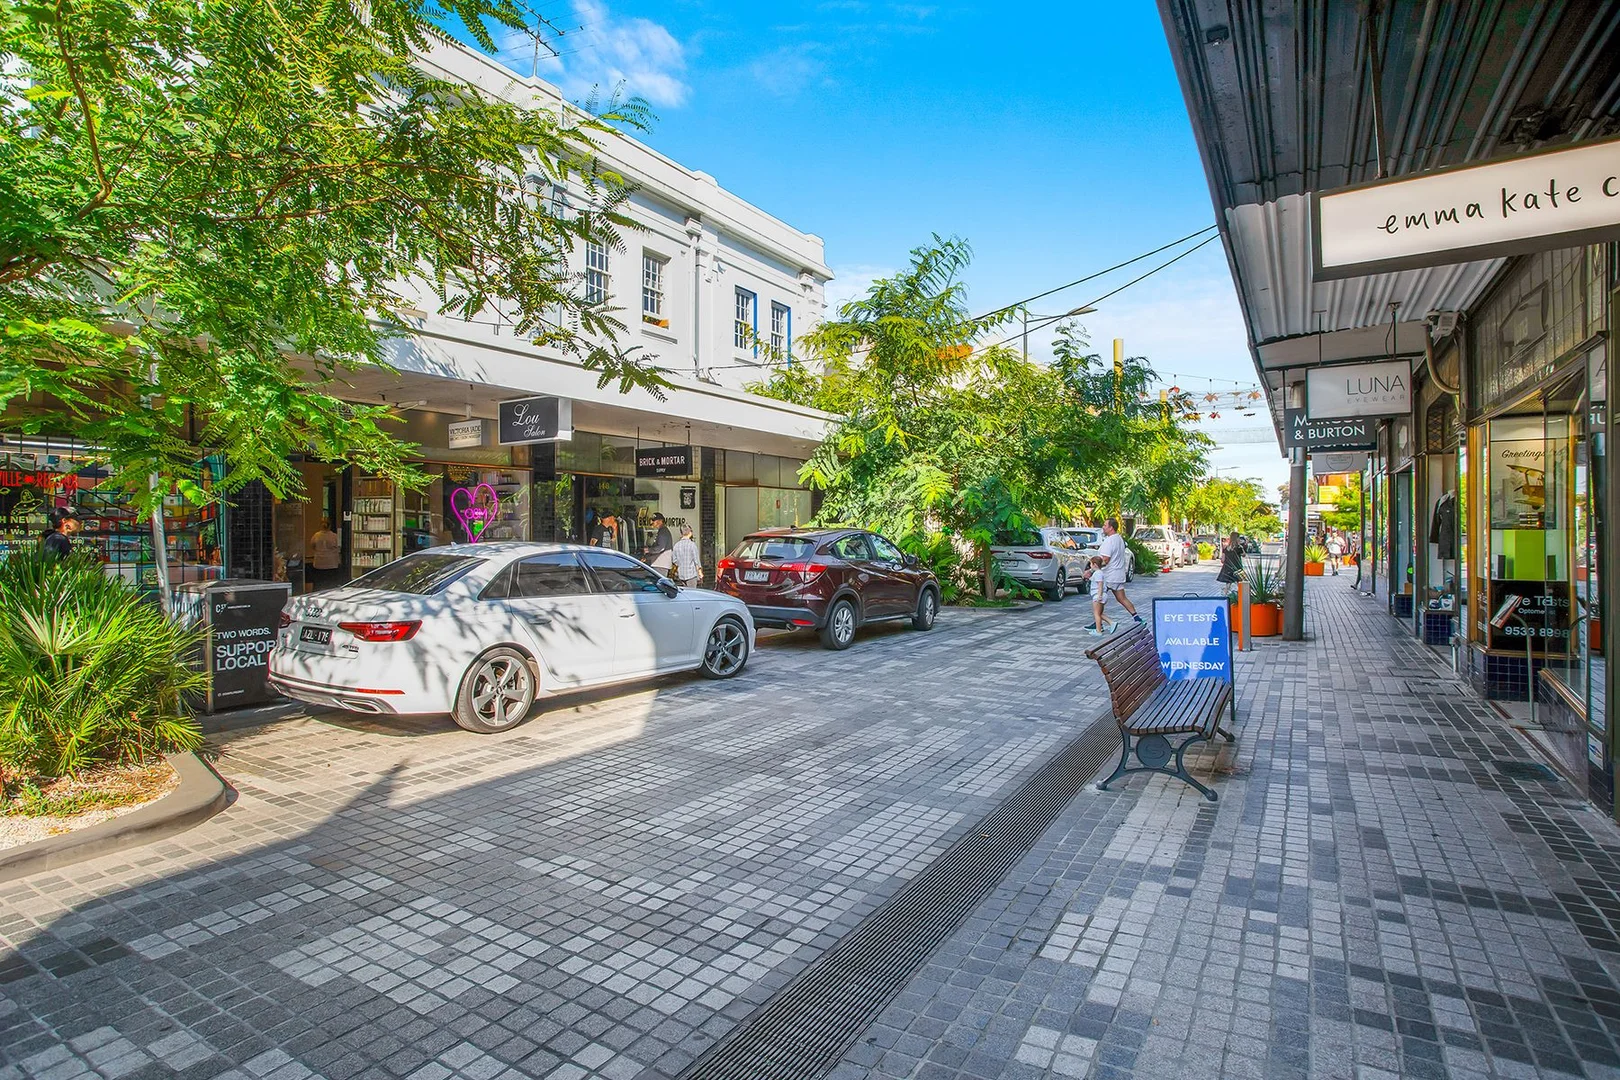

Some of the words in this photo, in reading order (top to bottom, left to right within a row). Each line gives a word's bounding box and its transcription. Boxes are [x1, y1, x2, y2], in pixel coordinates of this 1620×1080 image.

[1377, 201, 1485, 235] emma
[1501, 178, 1583, 219] kate
[1346, 375, 1406, 396] LUNA
[512, 403, 540, 427] Lou
[523, 424, 546, 438] Salon
[1294, 429, 1305, 441] &
[1308, 425, 1366, 440] BURTON
[639, 457, 656, 467] BRICK
[661, 455, 686, 466] MORTAR
[1164, 613, 1184, 622] EYE
[1187, 613, 1218, 622] TESTS
[217, 630, 237, 640] TWO
[239, 627, 272, 638] WORDS.
[1504, 626, 1536, 637] 9533
[1164, 637, 1220, 646] AVAILABLE
[216, 640, 276, 659] SUPPOR
[216, 654, 267, 672] LOCAL
[1160, 661, 1225, 671] WEDNESDAY
